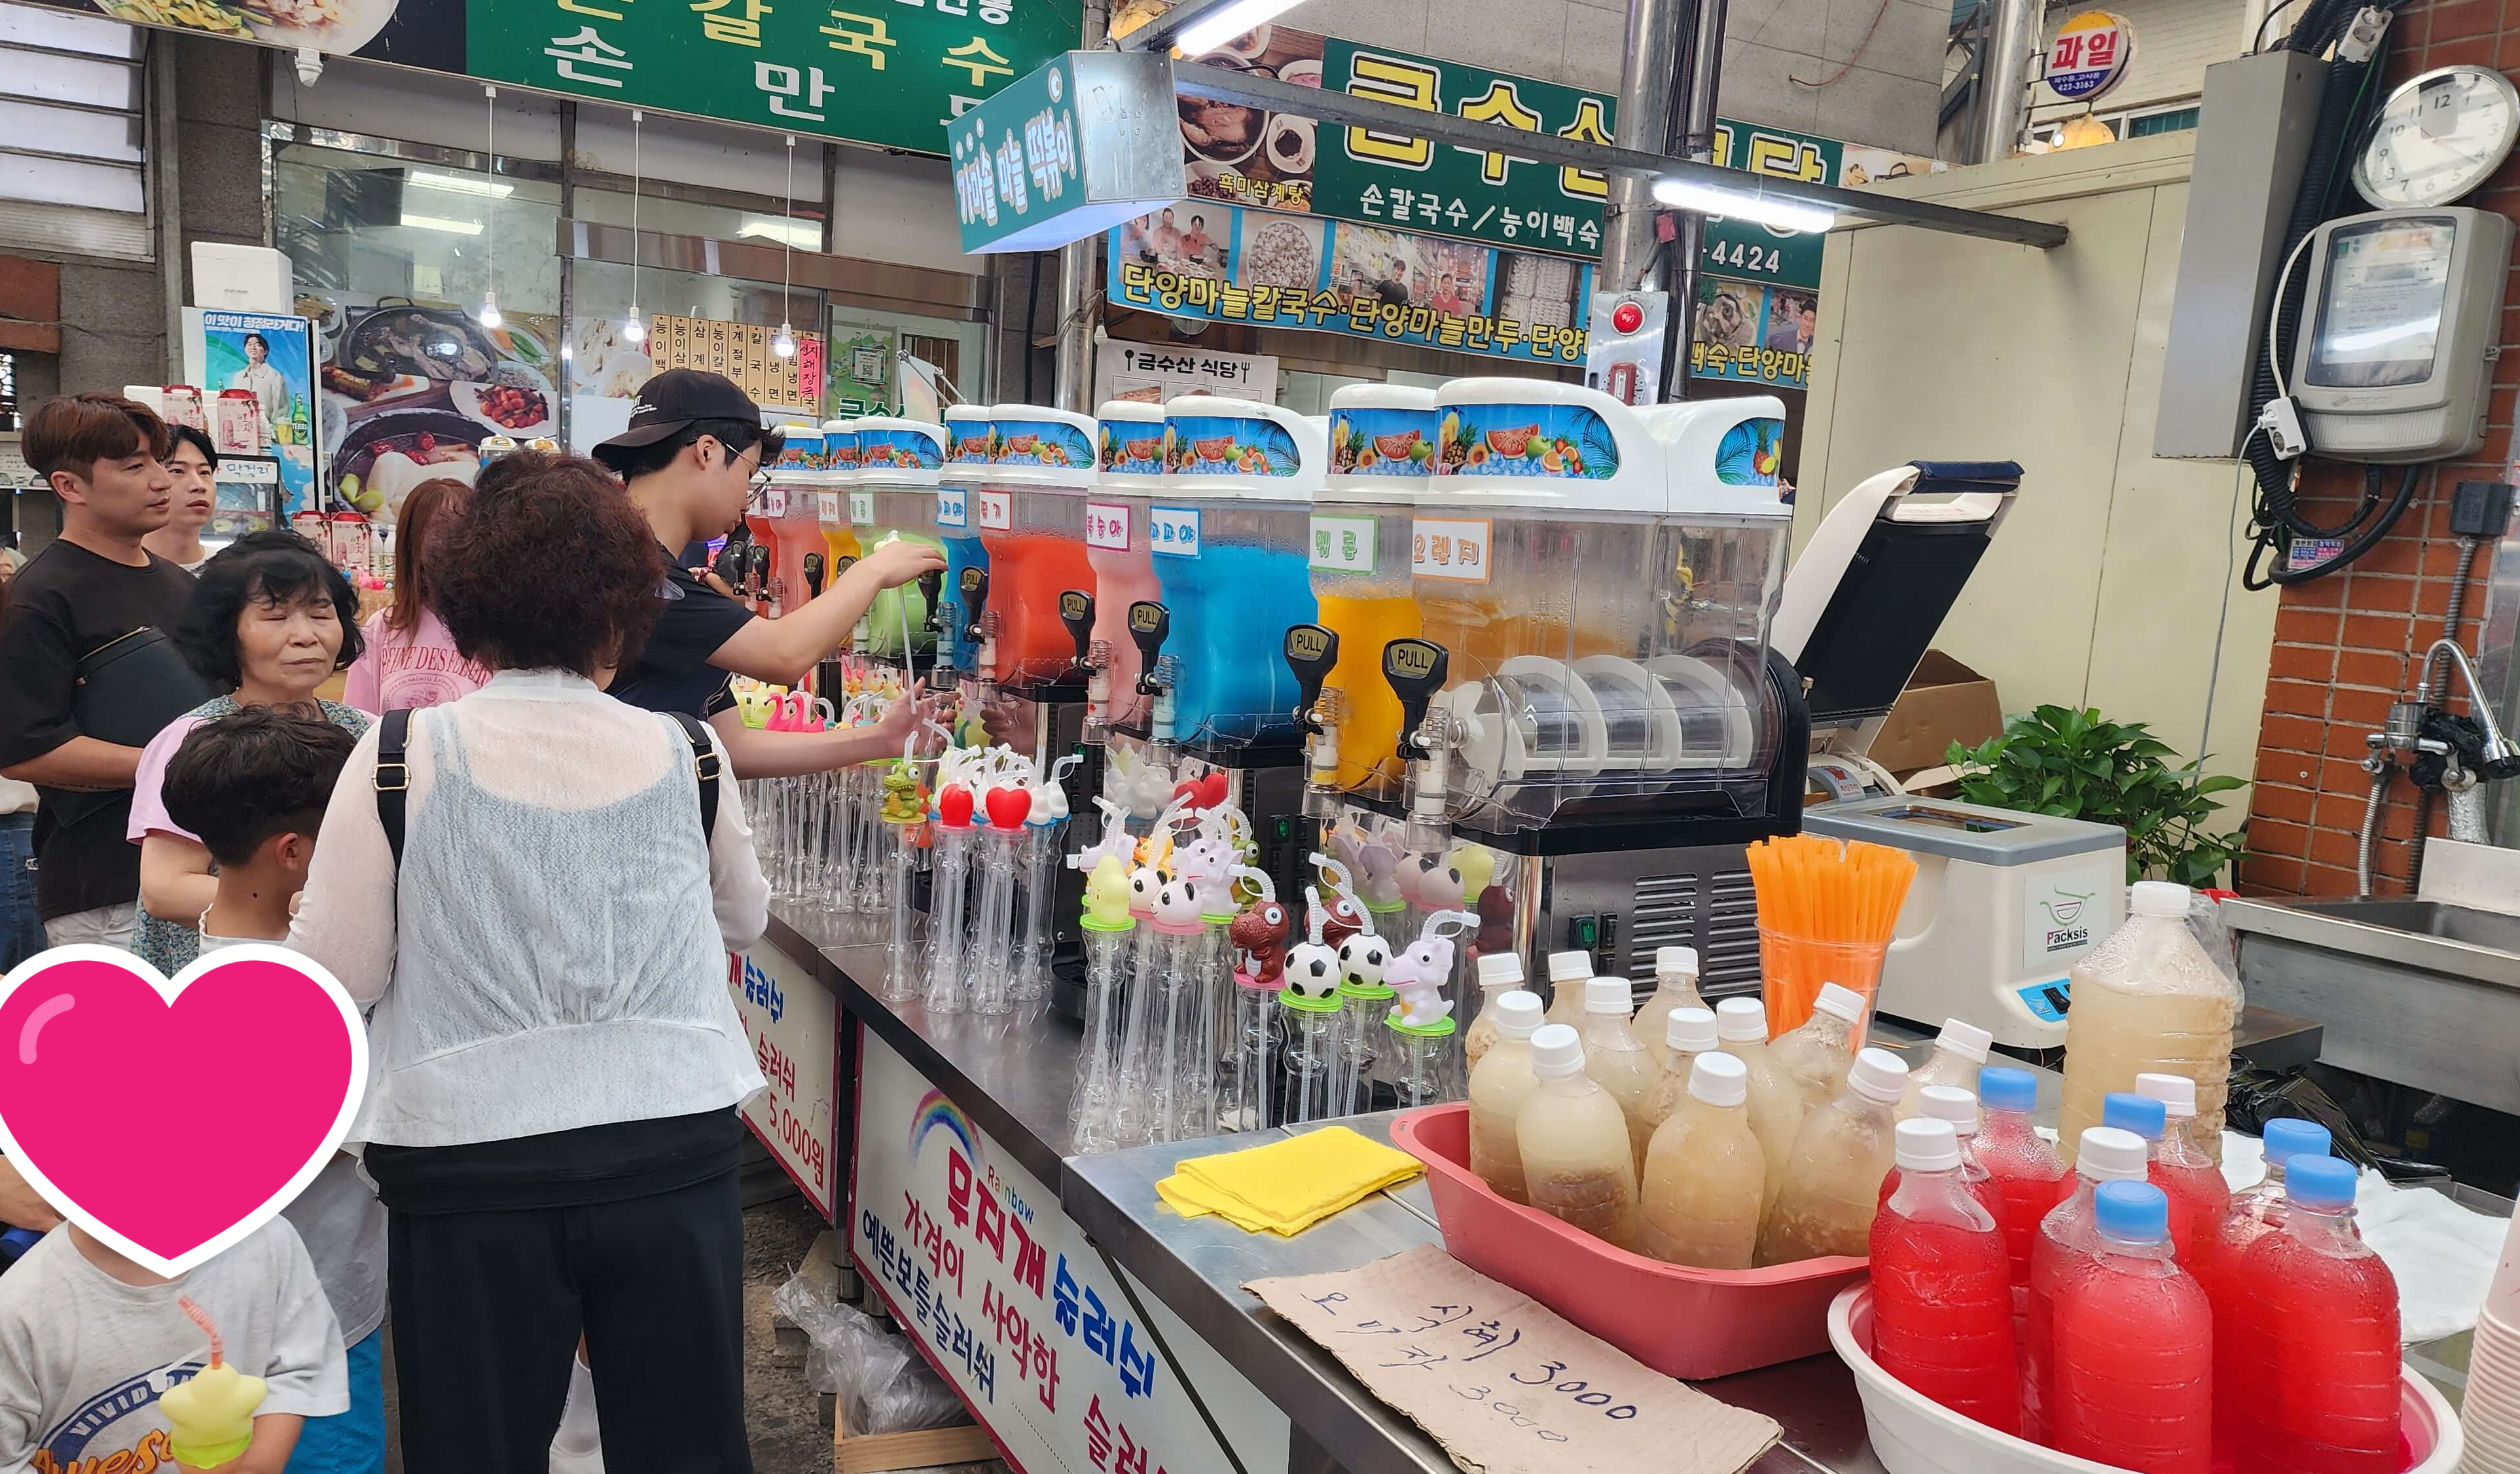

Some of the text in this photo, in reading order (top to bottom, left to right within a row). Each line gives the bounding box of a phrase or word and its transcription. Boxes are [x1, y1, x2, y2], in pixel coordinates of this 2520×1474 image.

[2052, 31, 2117, 69] 과일
[2434, 94, 2451, 109] 12
[996, 128, 1028, 215] 마늘
[1025, 106, 1077, 202] 떡볶이
[1219, 173, 1303, 204] 흑미삼계탕
[2400, 179, 2410, 192] 7
[205, 314, 217, 326] 이
[217, 315, 242, 327] 맛이
[674, 324, 687, 369] 능이삼
[749, 333, 763, 398] 칼국수
[1138, 353, 1238, 378] 금수산 식당
[1316, 530, 1357, 560] 멜론
[1414, 534, 1479, 565] 오렌지
[967, 573, 978, 585] PULL
[1067, 598, 1084, 613] PULL
[1137, 609, 1157, 625] PULL
[416, 646, 448, 671] DES
[1297, 634, 1322, 653] PULL
[1398, 649, 1428, 670] PULL
[2047, 926, 2088, 945] Packsis
[769, 1091, 824, 1191] 5,000원
[988, 1164, 1034, 1225] Rainbow
[947, 1145, 1047, 1301] 무지개
[903, 1189, 1168, 1474] 가격이 사악한 슬러
[69, 1386, 149, 1436] VIVID
